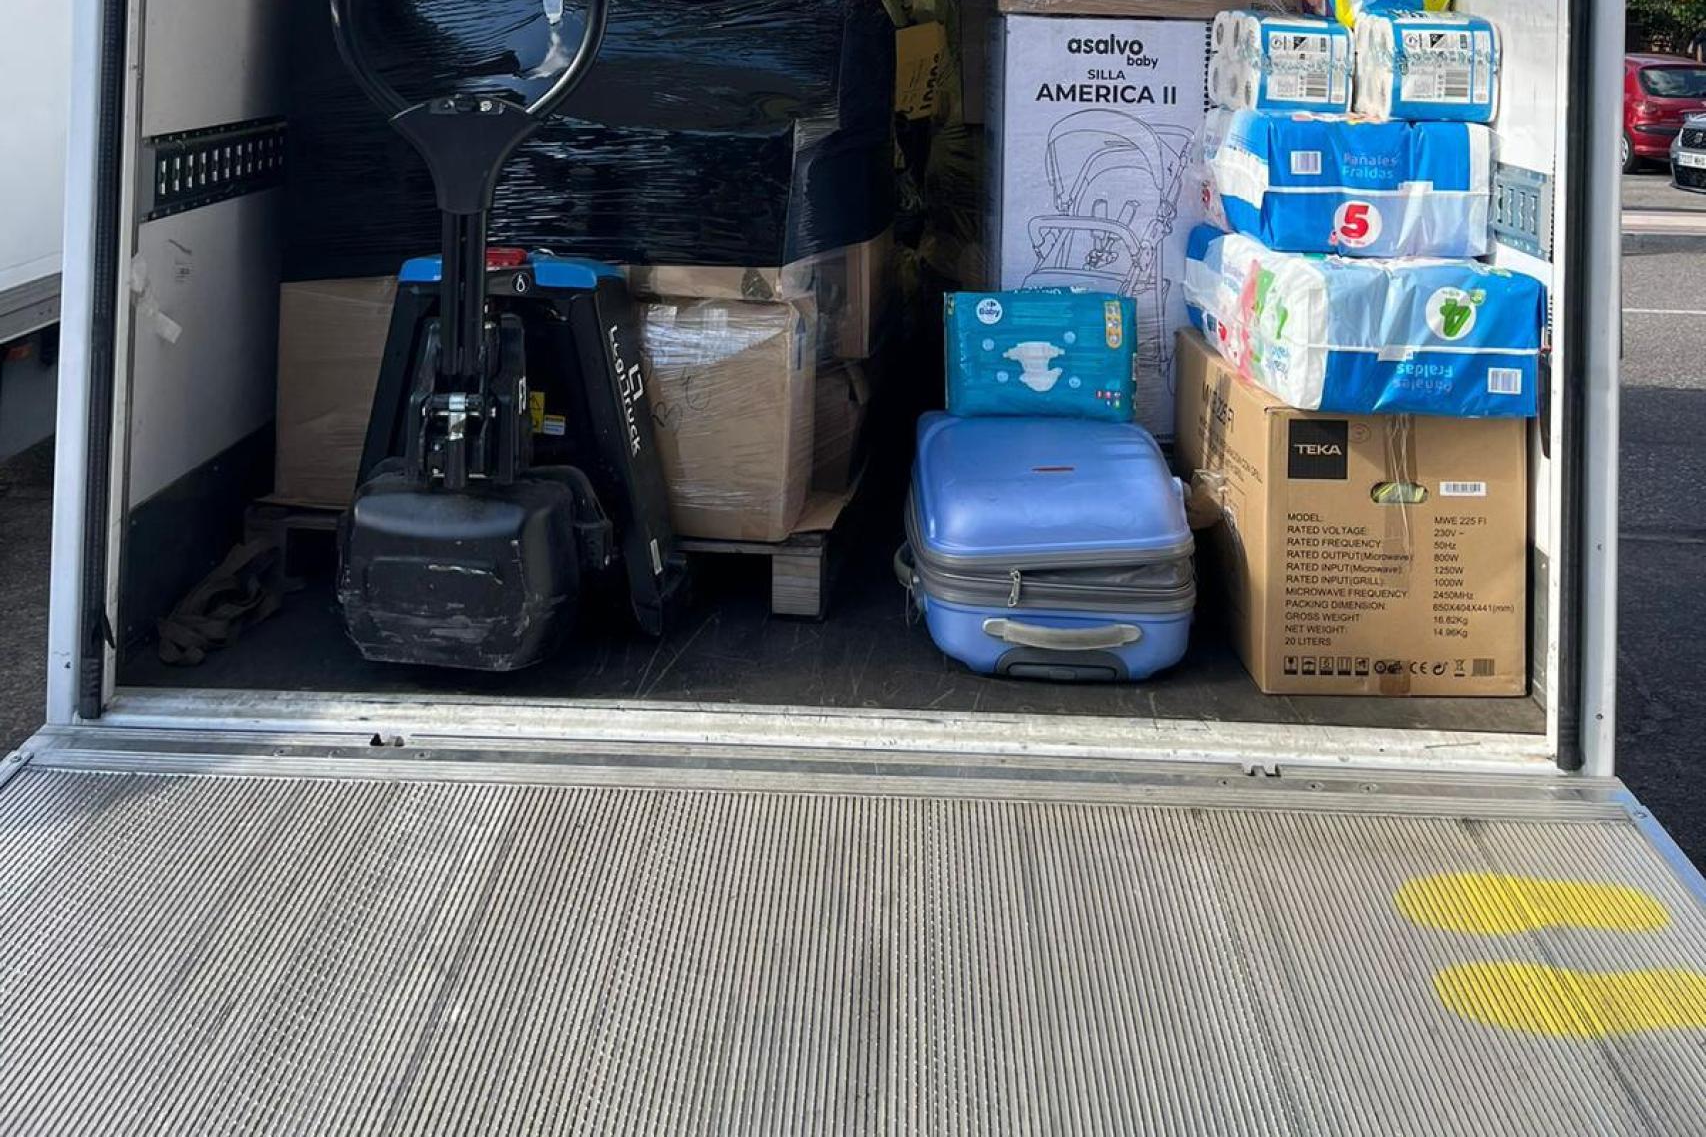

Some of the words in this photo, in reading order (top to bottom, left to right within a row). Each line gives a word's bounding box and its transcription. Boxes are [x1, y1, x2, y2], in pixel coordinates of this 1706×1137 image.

[1067, 34, 1144, 55] asalvo
[1127, 55, 1159, 69] baby
[1087, 69, 1126, 81] SILLA
[1035, 84, 1155, 105] AMERICA
[1163, 86, 1177, 105] II
[1343, 151, 1398, 167] Pañales
[1342, 165, 1394, 180] Fraldas
[1340, 204, 1370, 239] 5
[1440, 299, 1471, 337] 4
[1396, 363, 1454, 378] Fraldas
[1294, 444, 1343, 456] TEKA
[1459, 517, 1476, 525] 225
[1287, 525, 1320, 535] RATED
[1287, 538, 1320, 547] RATED
[1286, 550, 1319, 559] RATED
[1286, 562, 1319, 572] RATED
[1286, 575, 1319, 584] RATED
[1434, 578, 1464, 587] 1000W
[1285, 587, 1346, 597] MICROWAVE
[1433, 591, 1474, 600] 2450MHz
[1285, 599, 1328, 609] PACKING
[1285, 612, 1320, 621] GROSS
[1285, 624, 1304, 633] NET
[1285, 637, 1296, 646] 20
[1298, 637, 1332, 646] LITERS
